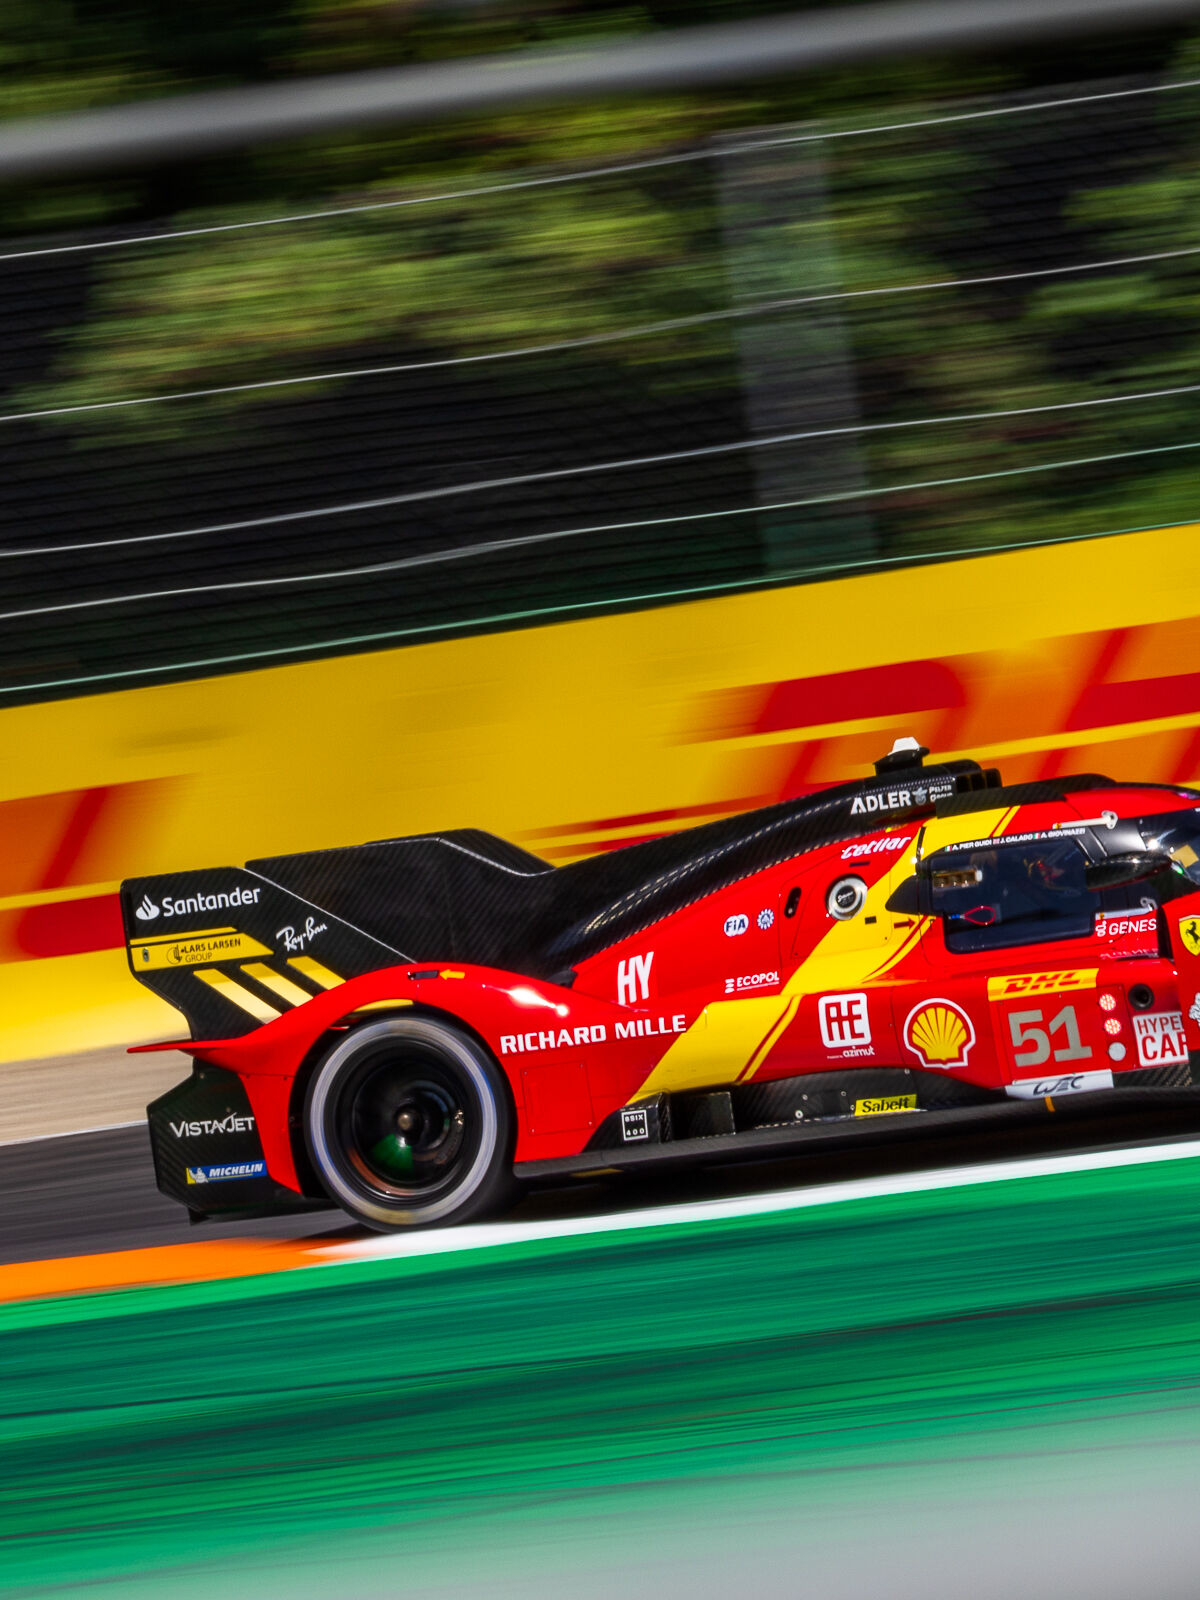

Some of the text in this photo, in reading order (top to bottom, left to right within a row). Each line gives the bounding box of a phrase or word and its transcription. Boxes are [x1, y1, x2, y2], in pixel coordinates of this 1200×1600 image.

[850, 790, 912, 815] ADLER
[162, 887, 260, 917] Santander
[183, 938, 241, 954] LARS LARSEN
[185, 953, 212, 963] GROUP
[617, 951, 654, 1006] HY
[737, 971, 779, 987] ECOPOL
[1004, 972, 1081, 994] DHL
[500, 1014, 687, 1054] RICHARD MILLE
[1137, 1016, 1183, 1035] HYPE
[1008, 1005, 1093, 1067] 51
[843, 1045, 875, 1058] azimut
[862, 1097, 910, 1113] Sabelt
[209, 1163, 263, 1177] MICHELIN
